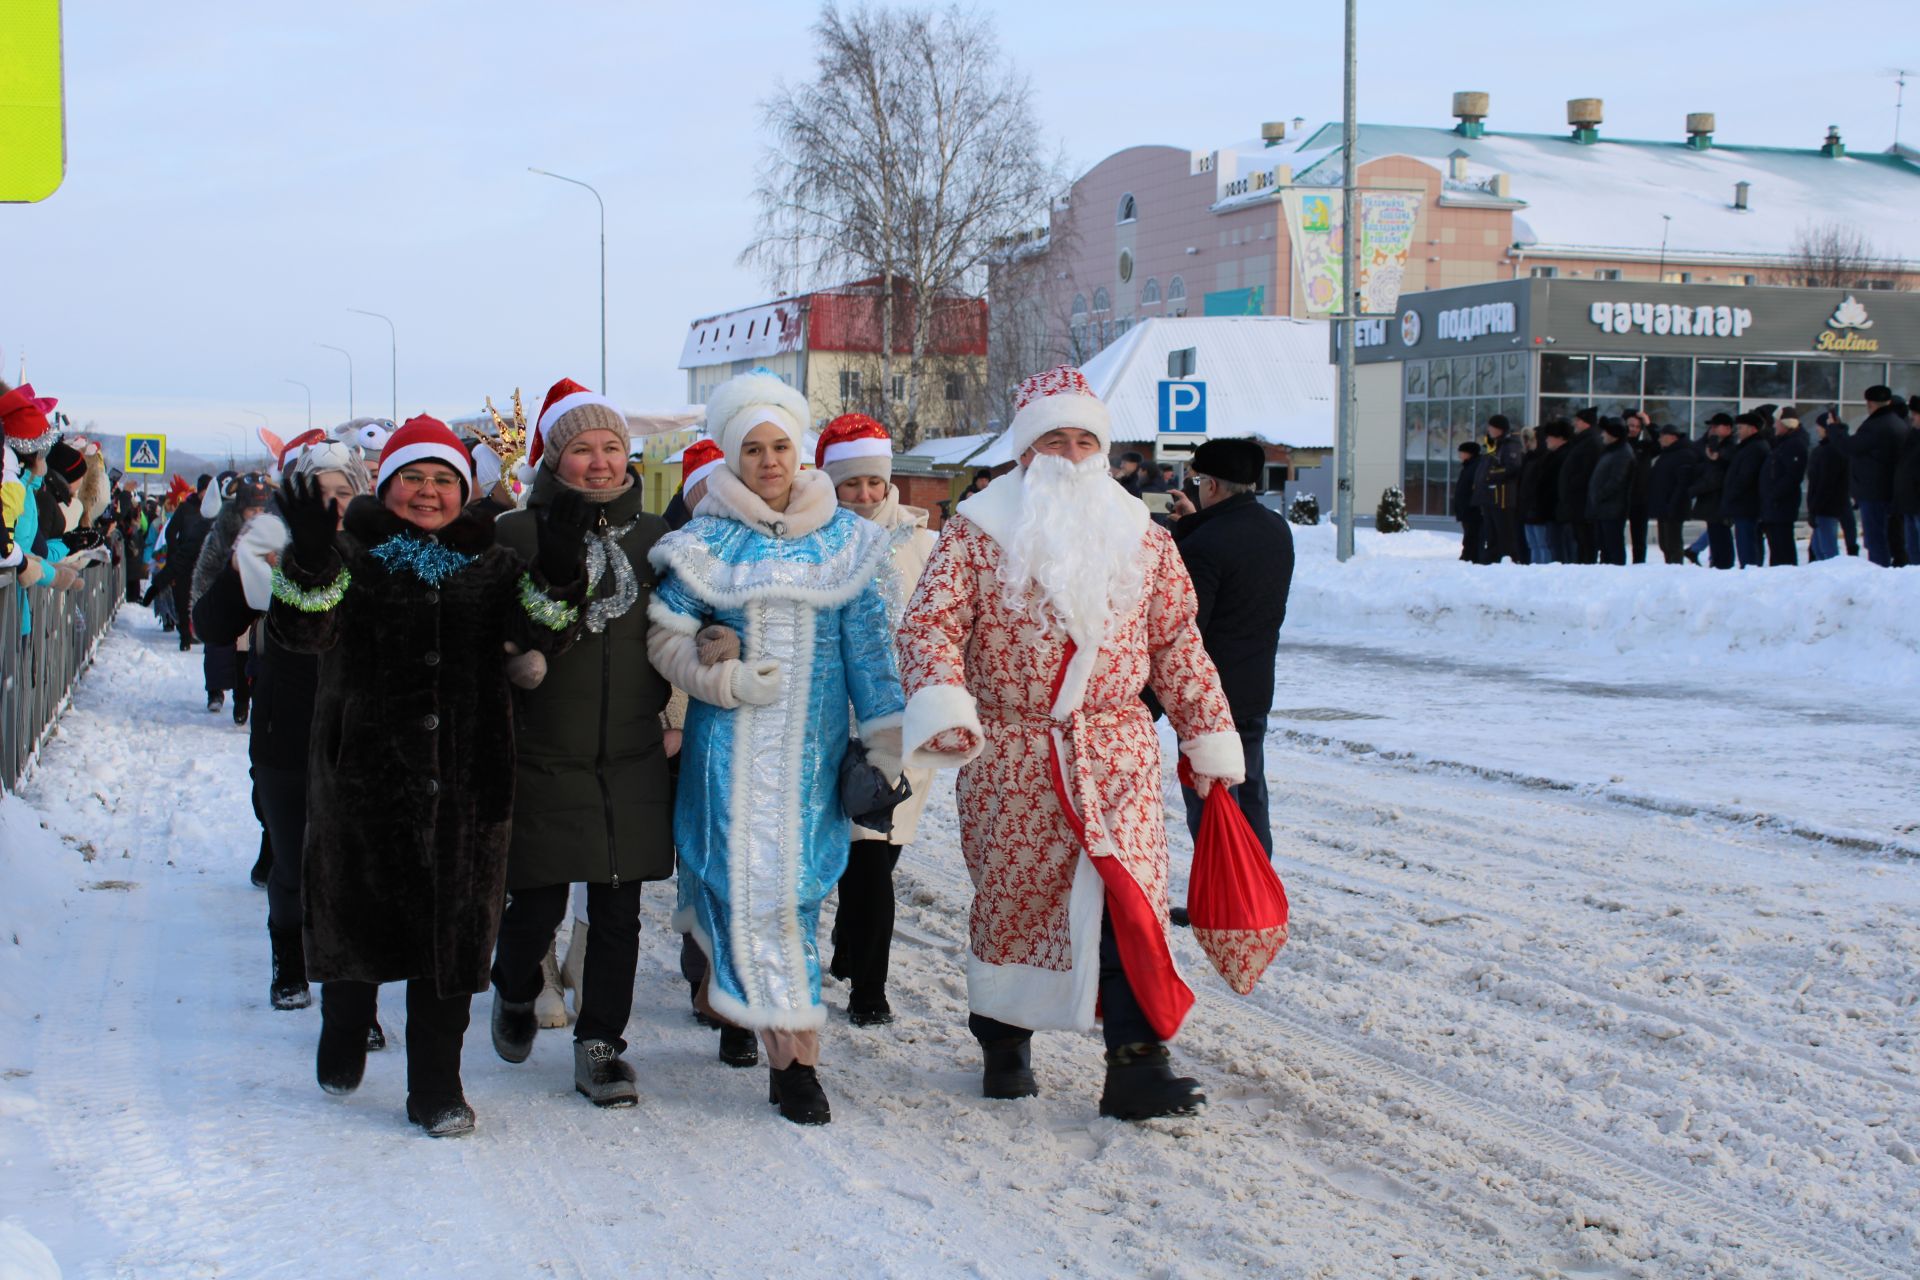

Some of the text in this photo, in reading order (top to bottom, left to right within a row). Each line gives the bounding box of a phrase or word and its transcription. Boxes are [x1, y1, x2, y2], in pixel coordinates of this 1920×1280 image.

[1337, 302, 1516, 348] ЕТЫ ПОДАРКИ
[1817, 331, 1878, 351] Ralina
[1169, 383, 1201, 431] P
